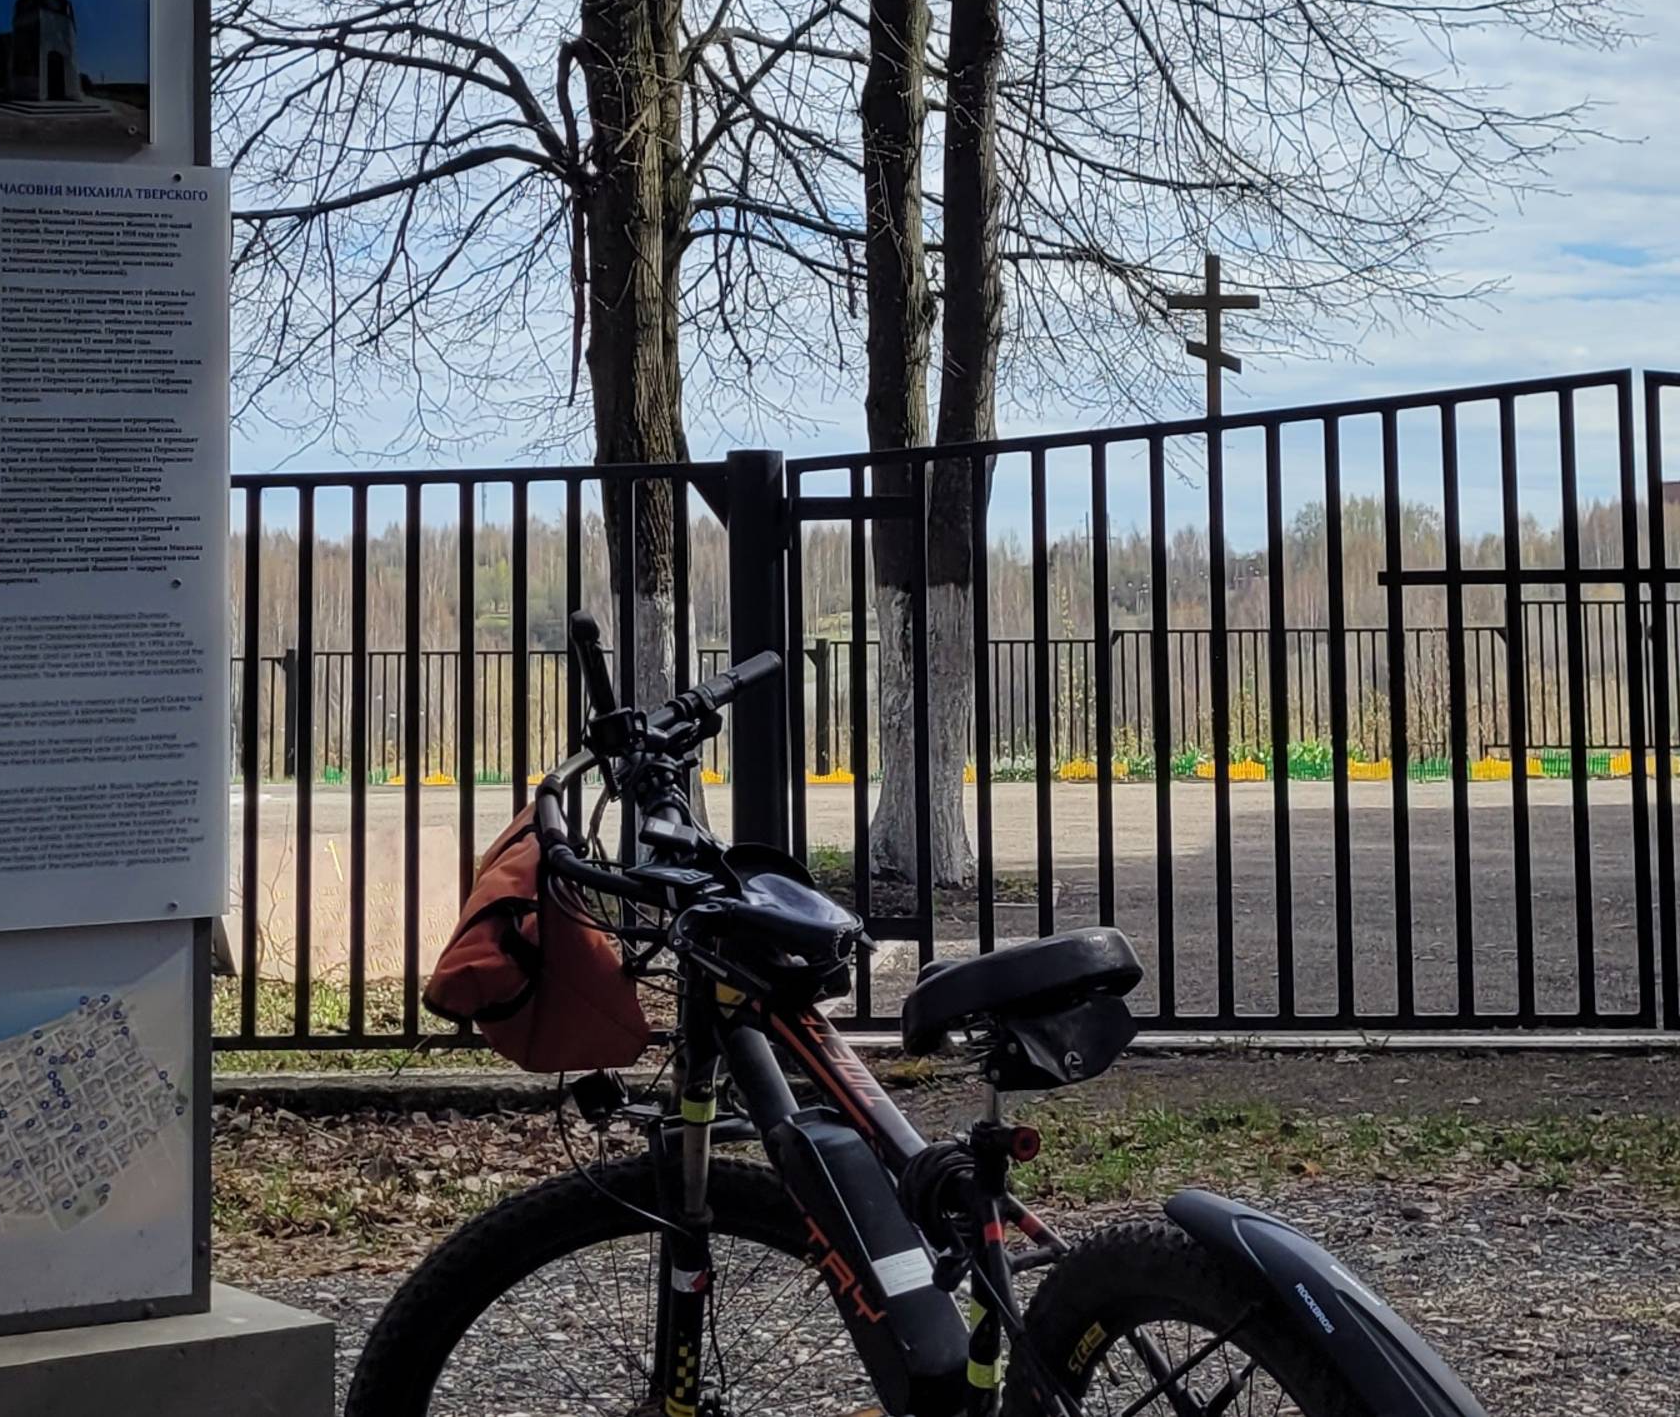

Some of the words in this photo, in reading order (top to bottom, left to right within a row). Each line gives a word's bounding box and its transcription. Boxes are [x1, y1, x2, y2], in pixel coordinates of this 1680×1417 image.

[0, 183, 63, 198] ЧАСОВНЯ
[65, 184, 134, 201] МИХАИЛА
[135, 188, 209, 202] ТВЕРСКОГО
[1295, 1283, 1336, 1334] ROCKBROS
